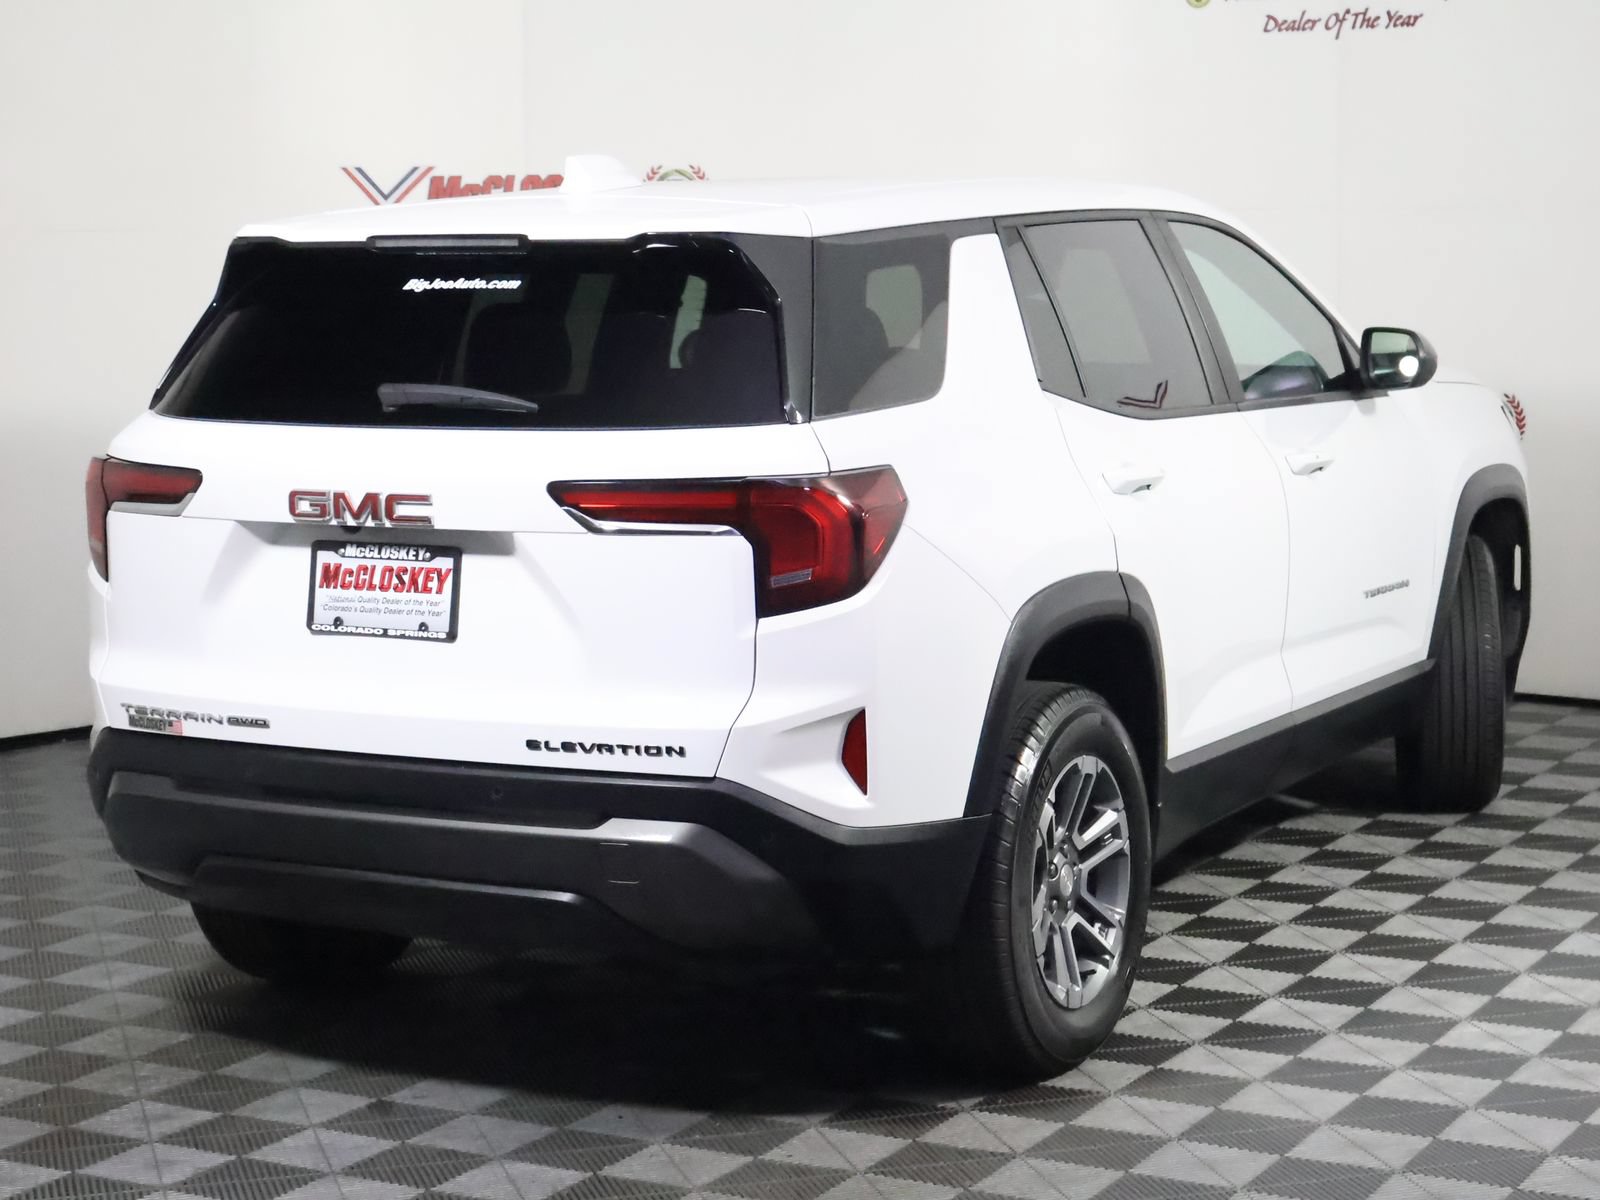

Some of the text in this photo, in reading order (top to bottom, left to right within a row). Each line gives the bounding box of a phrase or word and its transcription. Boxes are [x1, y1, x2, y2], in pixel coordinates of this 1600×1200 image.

[1263, 8, 1423, 40] Dealer Of The Year
[288, 489, 434, 528] GMC
[345, 543, 426, 561] McCLOSKEY
[319, 562, 452, 594] McCLOSKEY
[357, 595, 381, 605] Quality
[381, 597, 403, 605] Dealer
[404, 598, 412, 607] of
[412, 598, 424, 607] the
[359, 605, 382, 615] Quality
[383, 607, 404, 616] Dealer
[406, 608, 414, 617] of
[414, 609, 426, 617] the
[311, 624, 447, 639] COLORADO SPRINGS
[120, 702, 270, 728] TERRAIN AWD
[525, 739, 687, 758] ELEVATION
